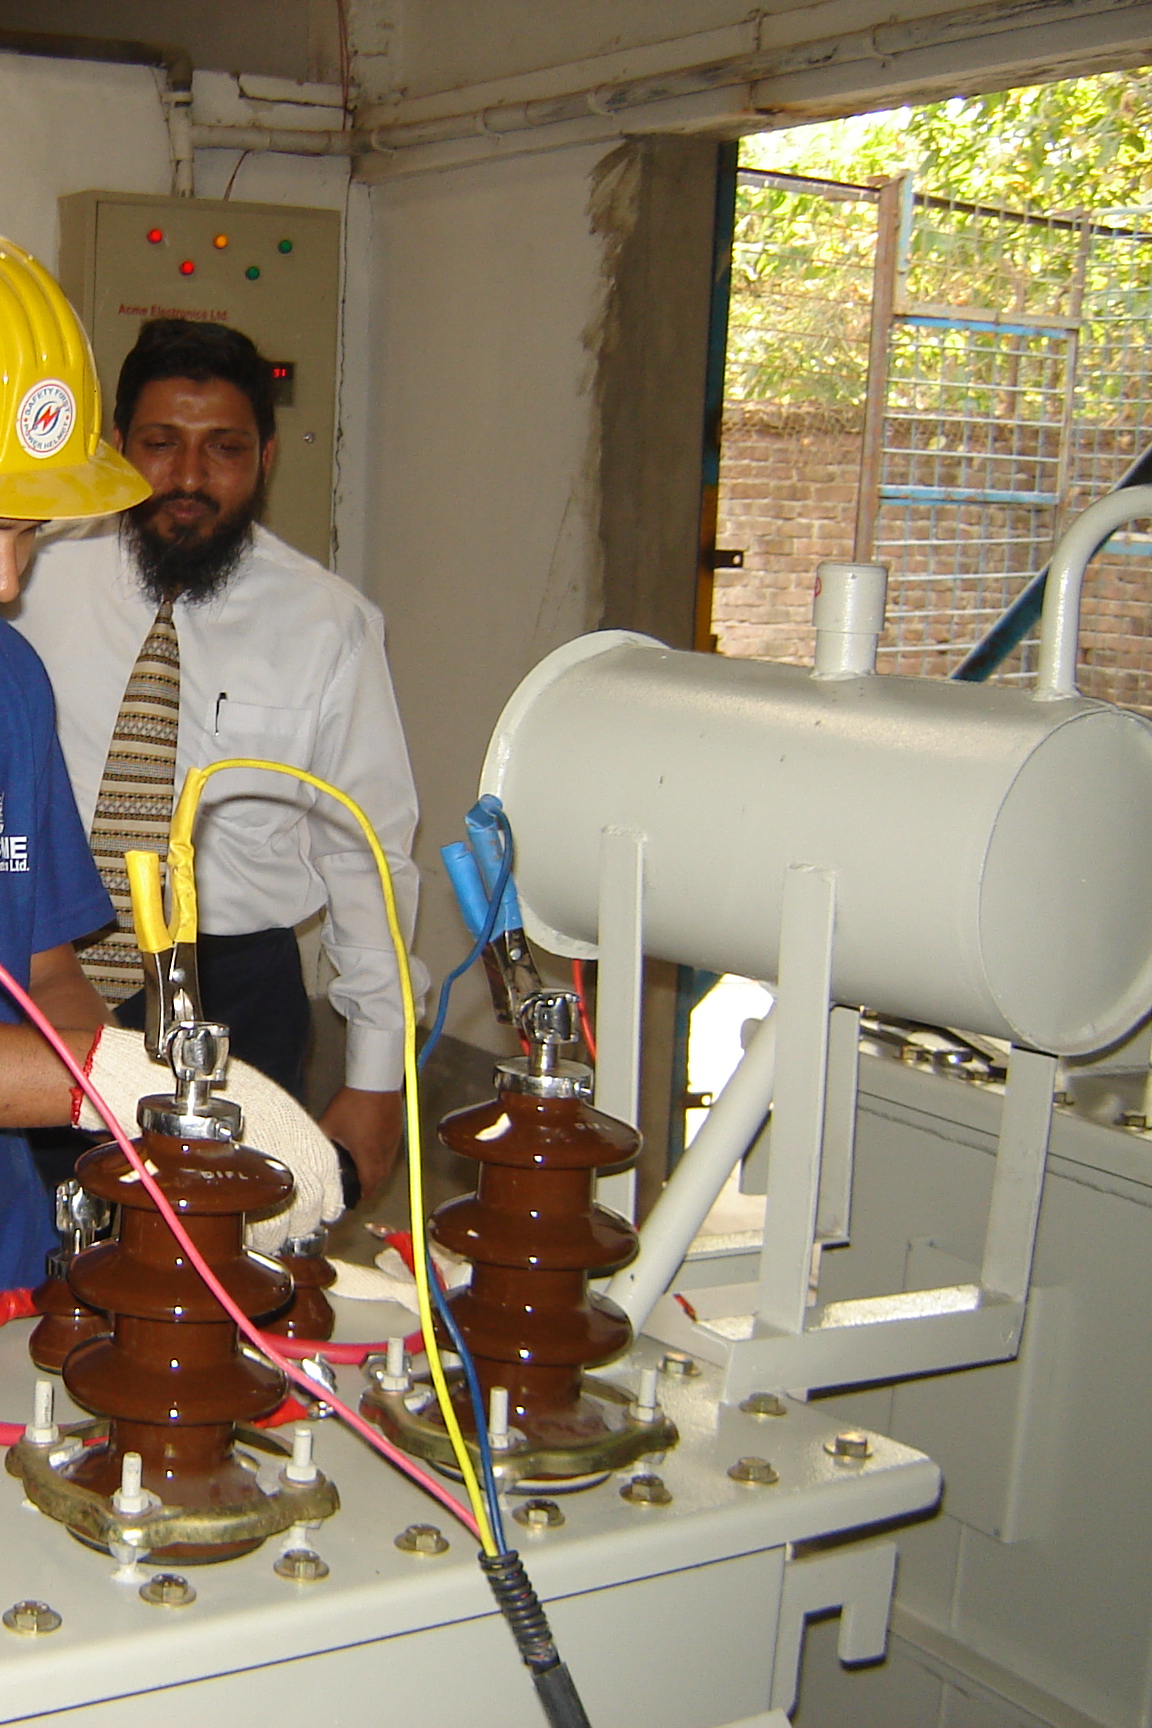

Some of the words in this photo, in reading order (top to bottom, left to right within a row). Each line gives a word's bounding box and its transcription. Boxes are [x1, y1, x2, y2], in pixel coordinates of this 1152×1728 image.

[118, 304, 147, 316] Acme
[25, 388, 54, 416] SAFETY
[9, 859, 30, 872] Ltd.
